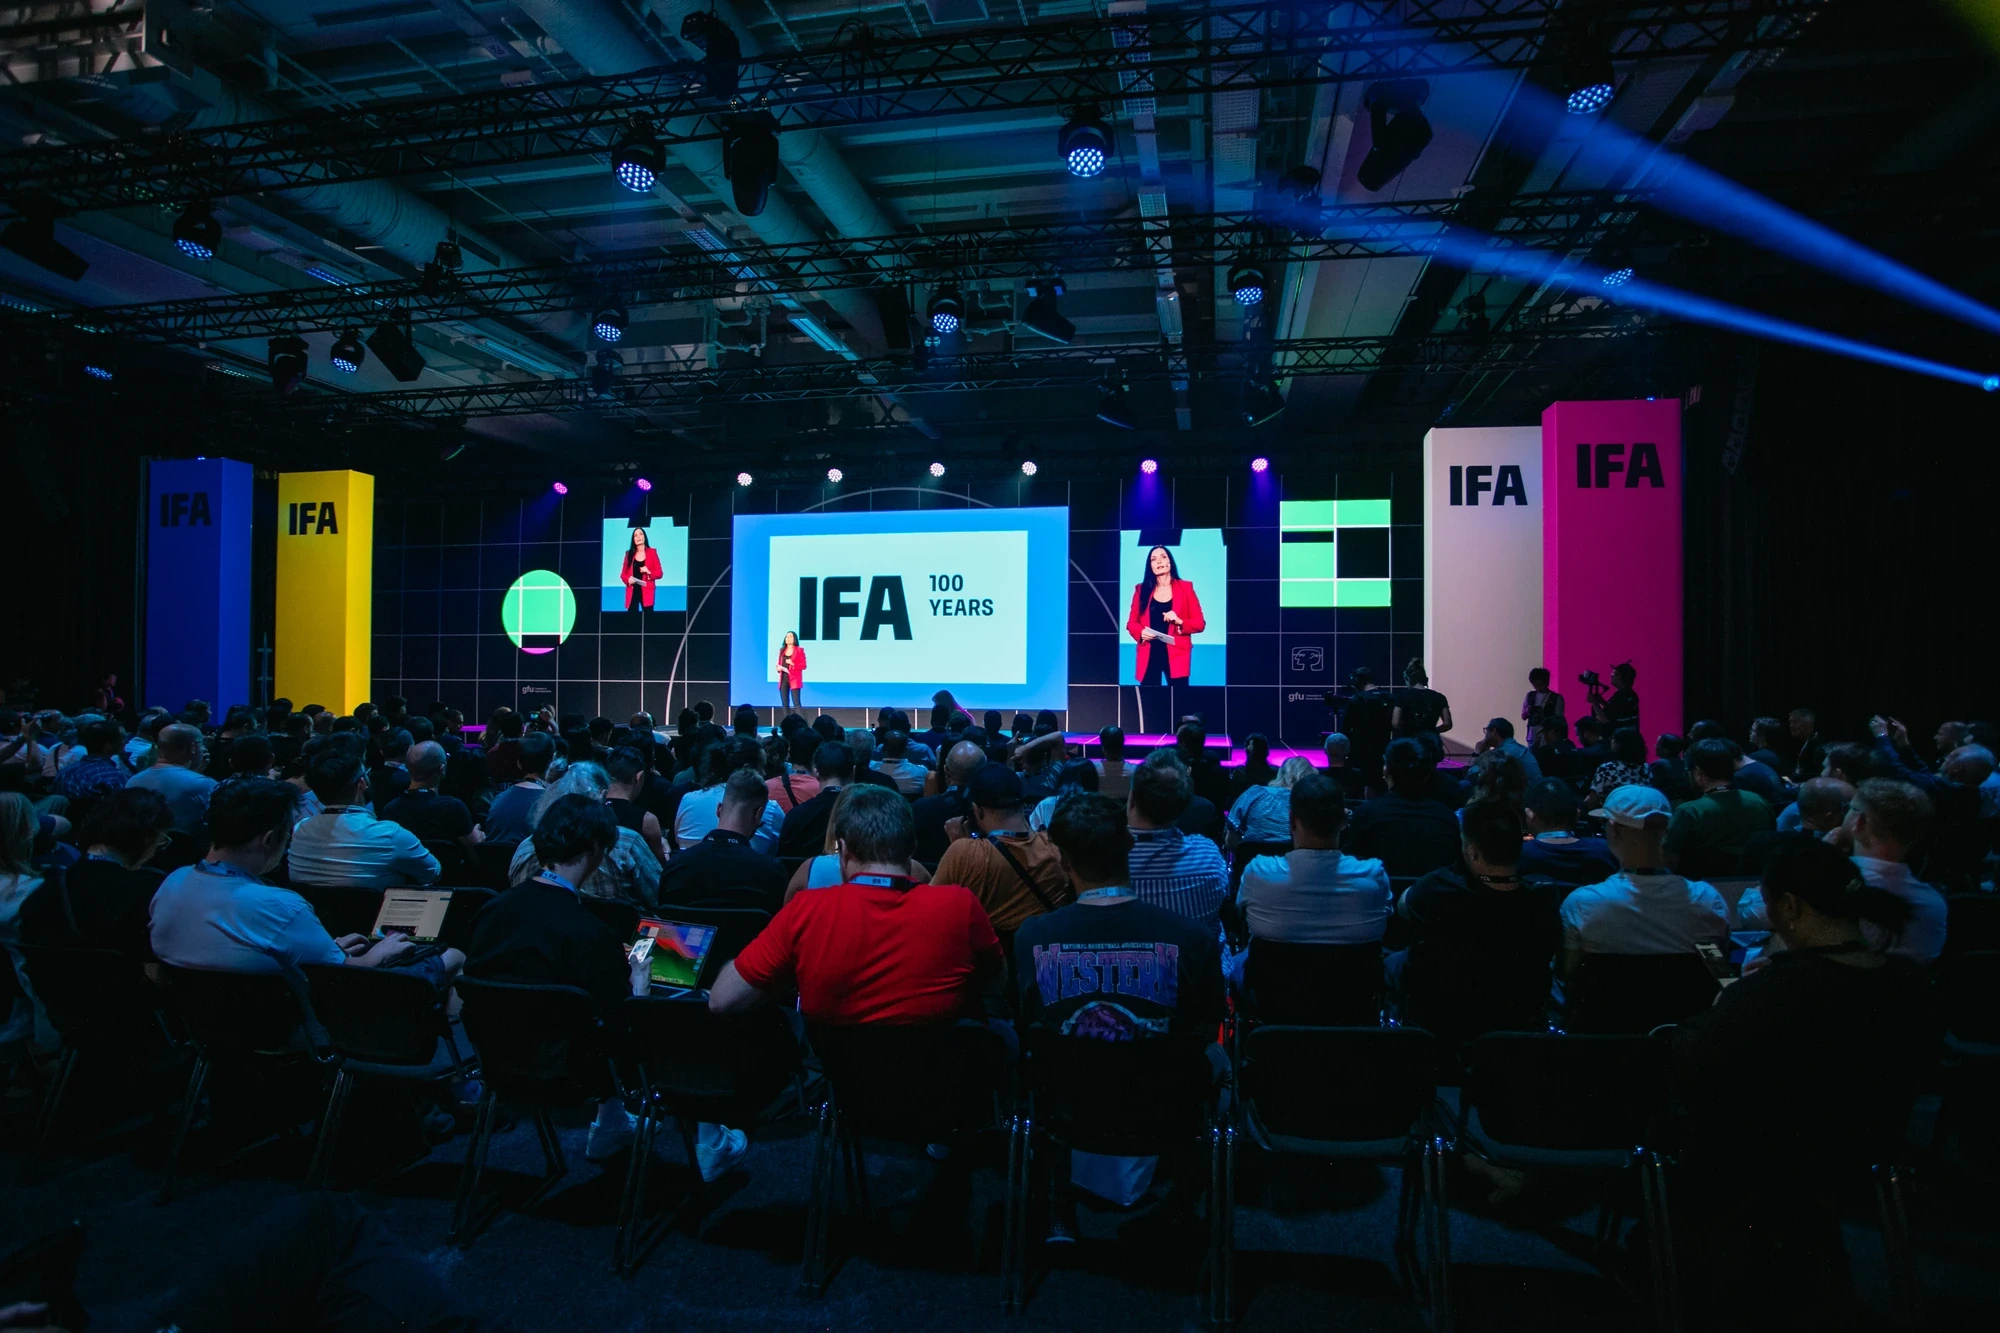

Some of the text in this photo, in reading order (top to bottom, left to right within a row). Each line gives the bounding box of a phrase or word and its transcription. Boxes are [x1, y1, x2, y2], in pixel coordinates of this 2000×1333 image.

[1576, 443, 1665, 489] IFA
[1449, 465, 1528, 506] IFA
[160, 492, 212, 528] IFA
[289, 502, 339, 535] IFA
[929, 575, 963, 592] 100
[799, 575, 913, 641] IFA
[929, 599, 994, 616] YEARS
[522, 686, 534, 695] gfu
[1288, 692, 1304, 702] gfu
[1033, 942, 1179, 1008] WESTERN
